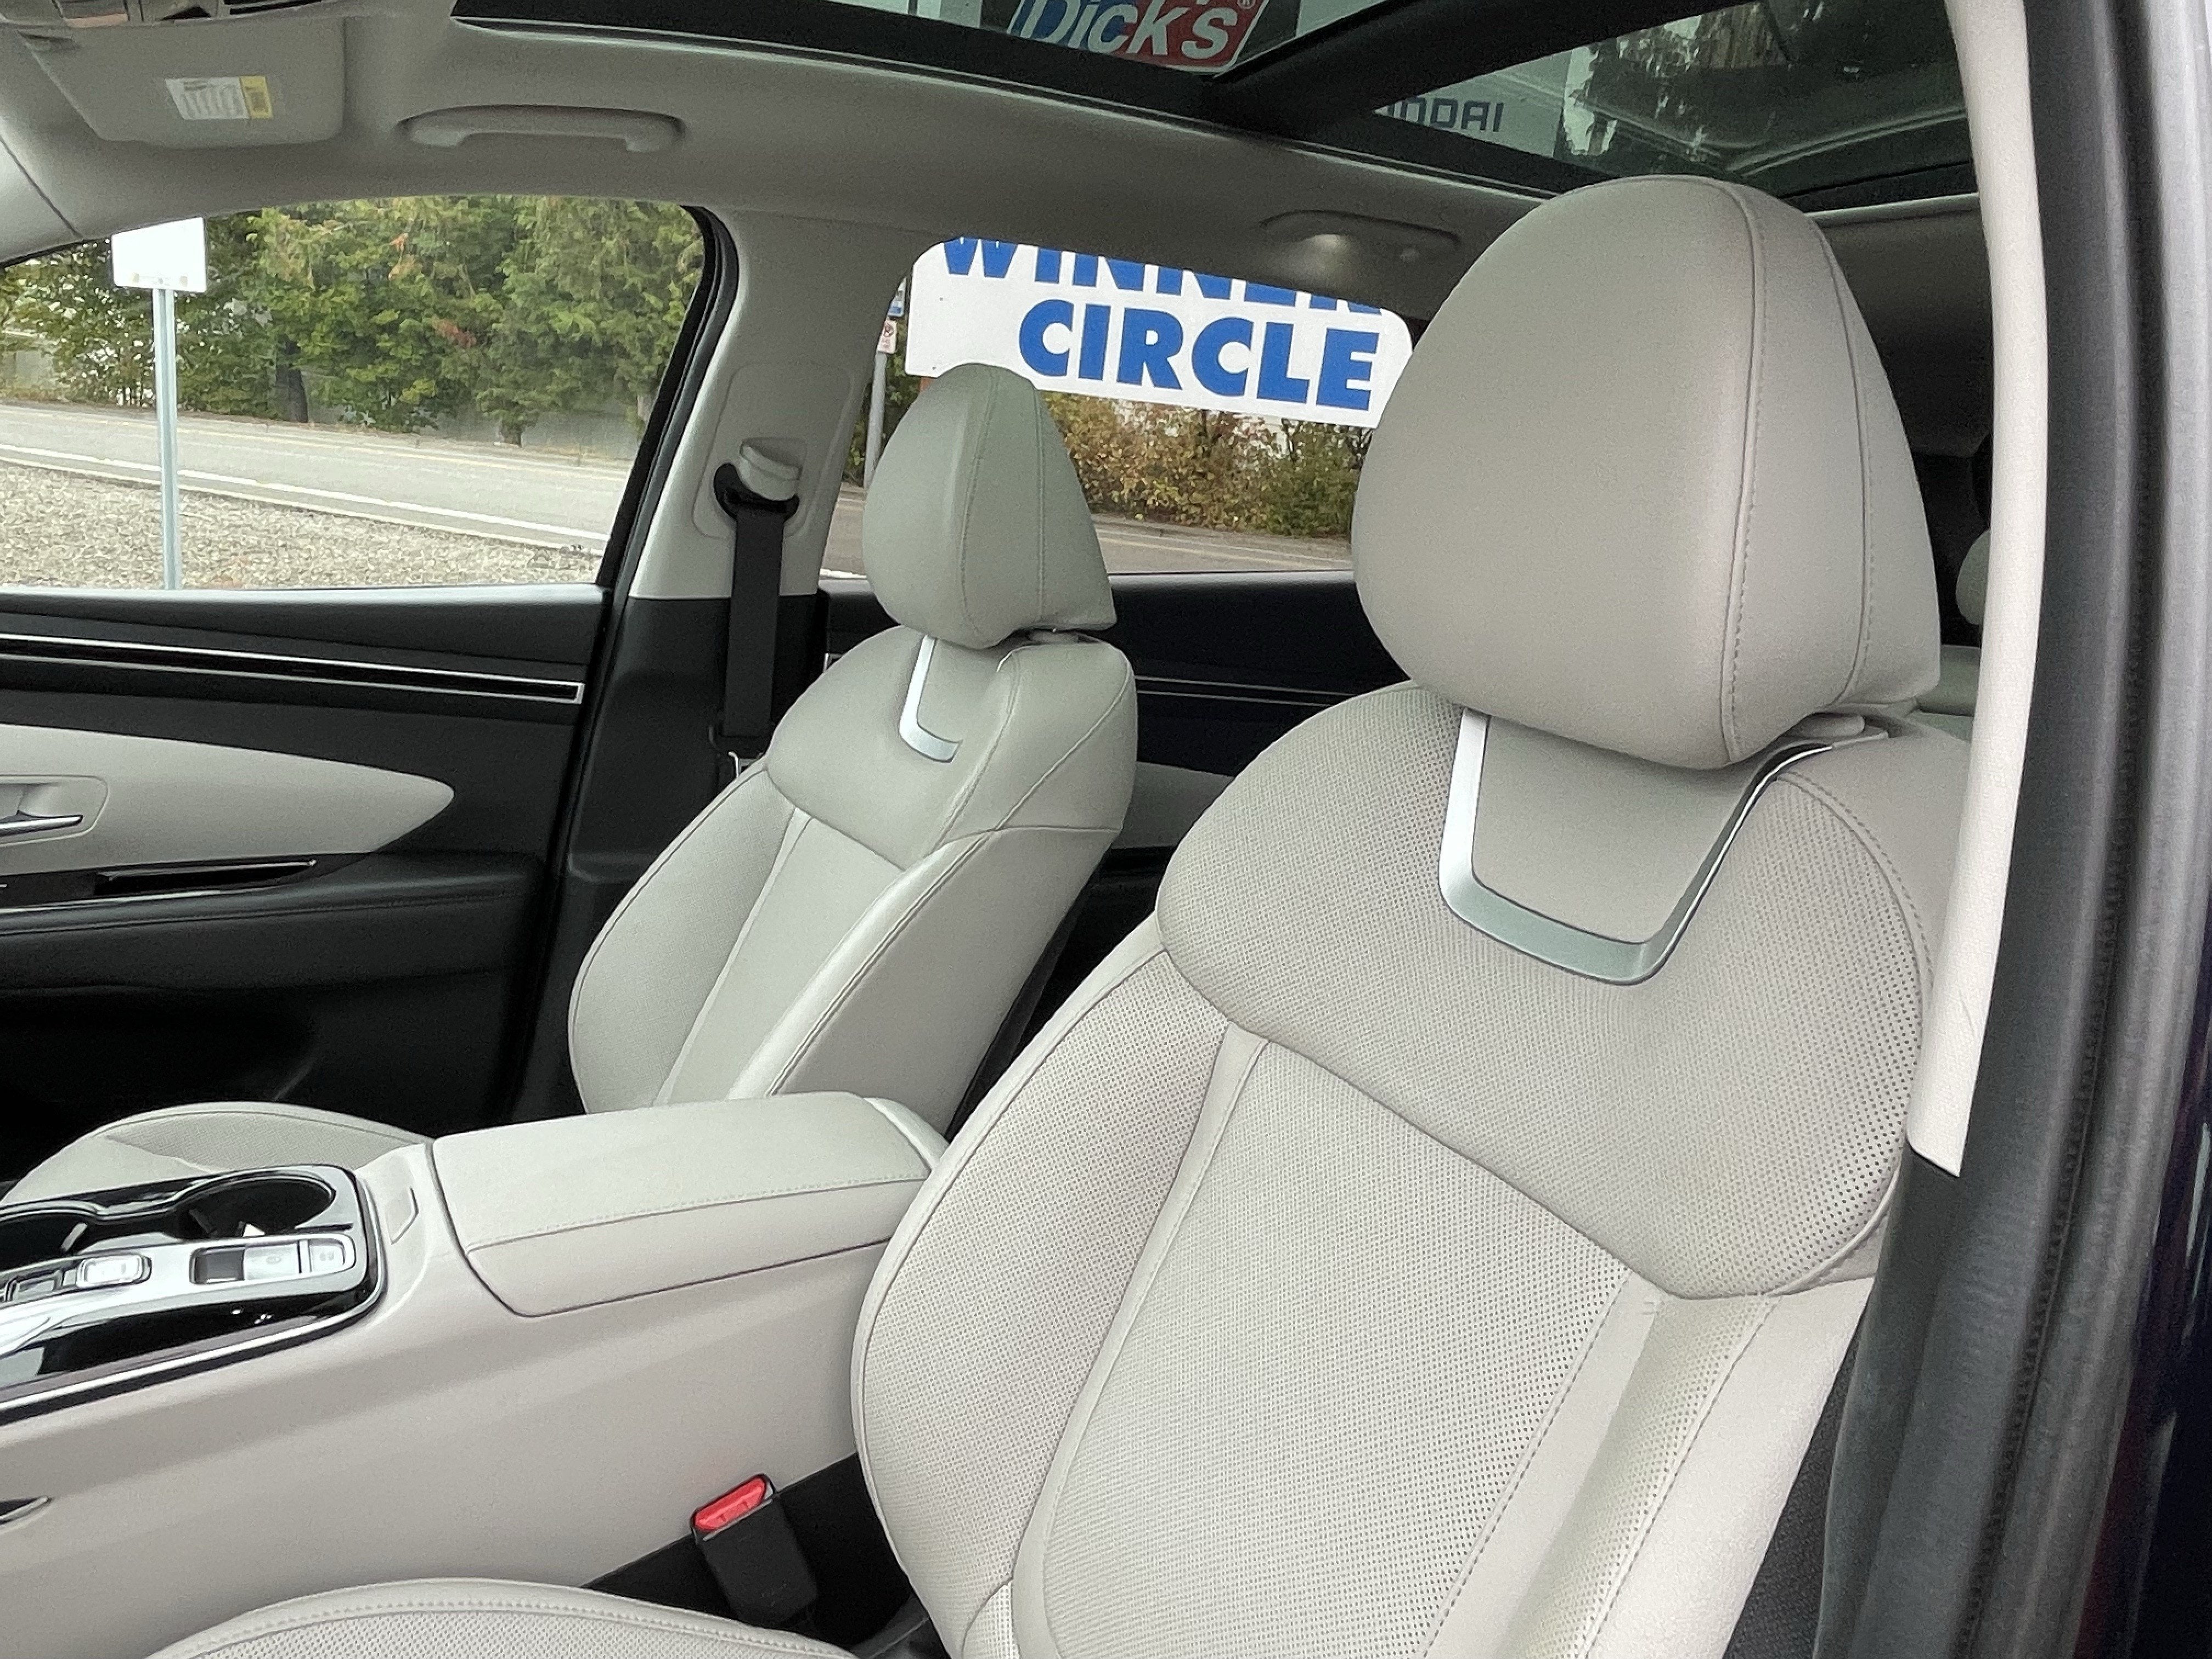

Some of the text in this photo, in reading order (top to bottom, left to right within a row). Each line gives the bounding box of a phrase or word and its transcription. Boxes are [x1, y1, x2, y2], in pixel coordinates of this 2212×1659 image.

[1020, 0, 1238, 59] Dicks
[1387, 97, 1504, 133] NDAI
[1019, 298, 1379, 411] CIRCLE
